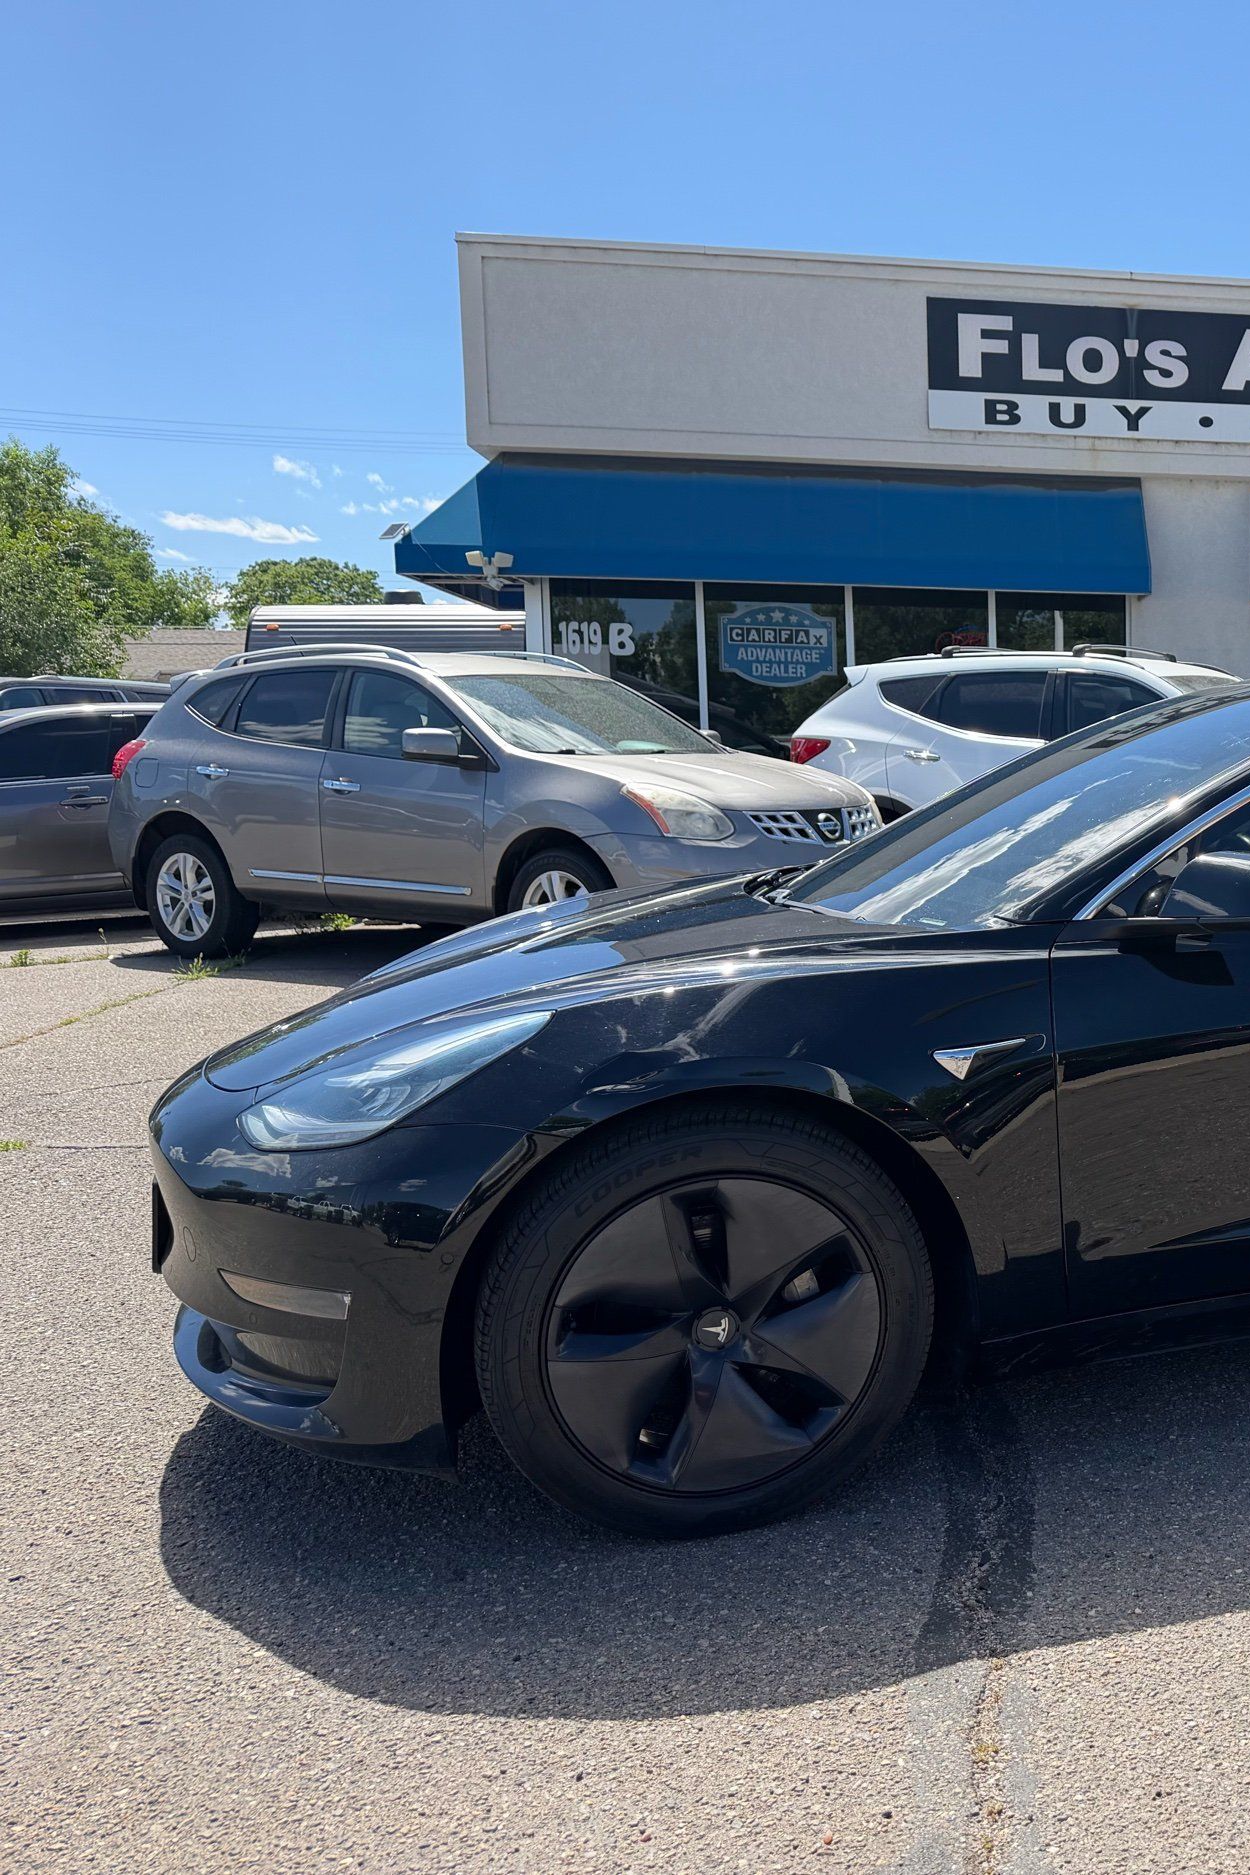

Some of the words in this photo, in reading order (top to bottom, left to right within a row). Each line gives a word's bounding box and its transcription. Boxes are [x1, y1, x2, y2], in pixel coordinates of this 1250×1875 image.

[957, 312, 1189, 389] FLO'S
[984, 398, 1153, 432] BUY
[558, 621, 602, 656] 1619
[608, 622, 635, 656] B
[729, 627, 825, 646] CARFAX
[737, 647, 820, 663] ADVANTAGE
[752, 663, 806, 677] DEALER
[574, 1146, 703, 1218] COOPER
